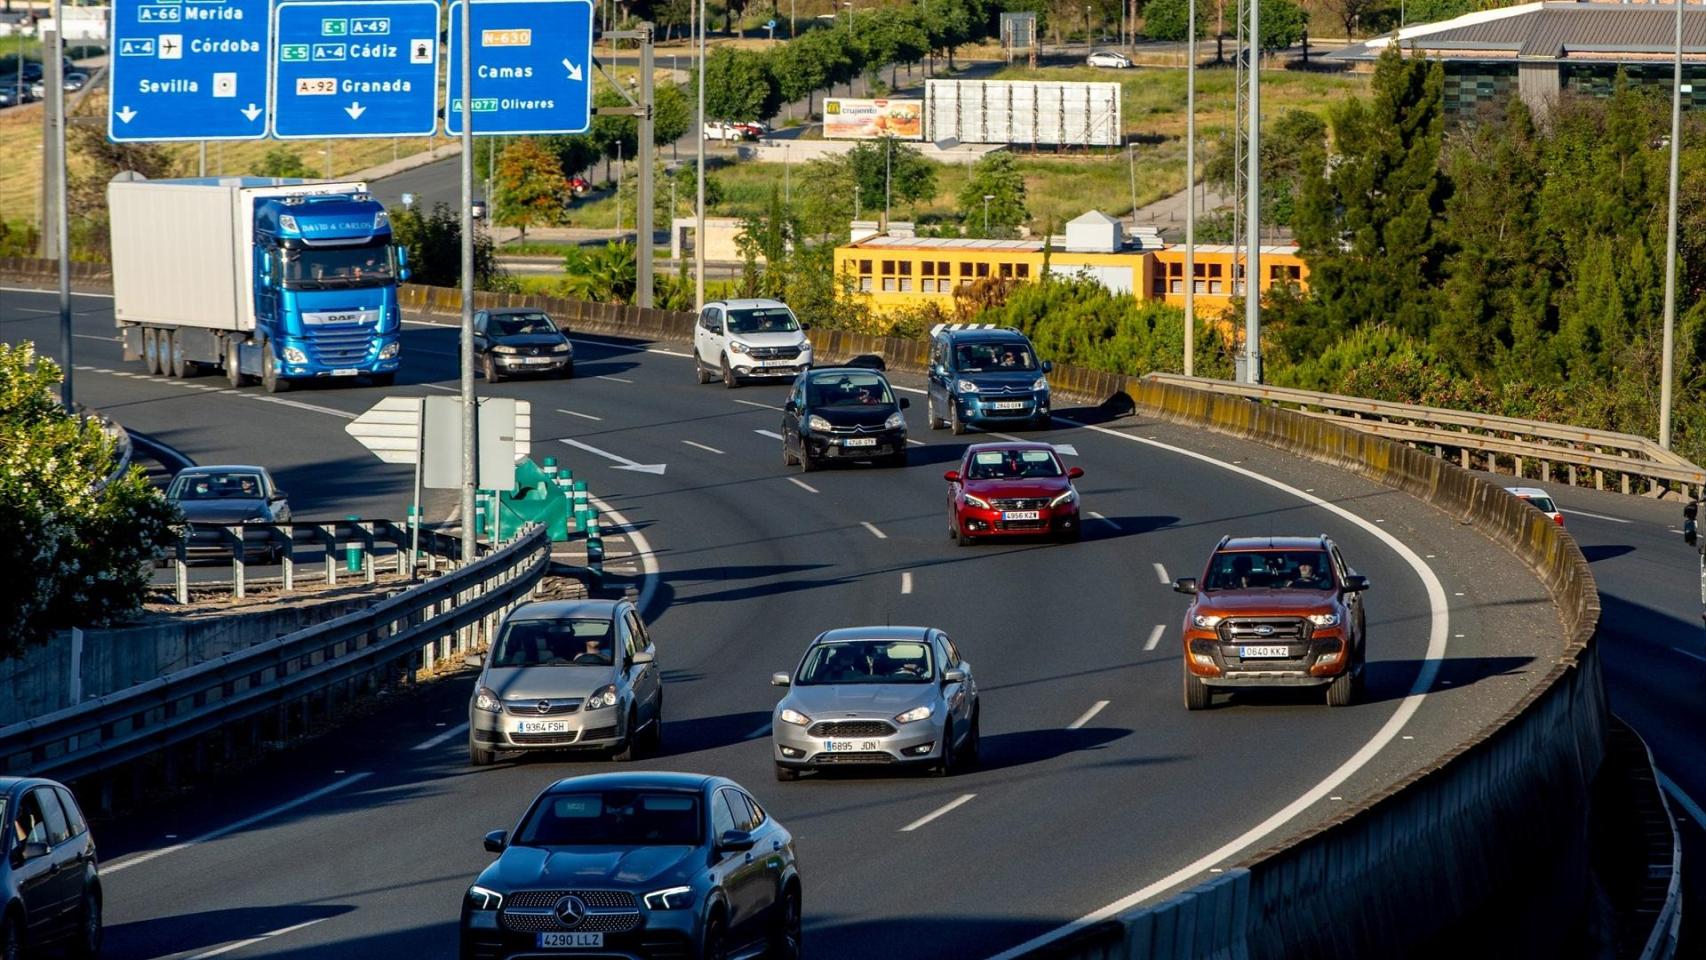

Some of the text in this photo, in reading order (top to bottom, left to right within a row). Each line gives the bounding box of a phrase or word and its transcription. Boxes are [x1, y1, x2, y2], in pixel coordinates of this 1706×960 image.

[141, 6, 243, 20] A-66 Merida
[323, 20, 388, 33] E-1 A-49
[484, 32, 529, 44] N-630
[122, 38, 259, 54] A-4 Córdoba
[282, 43, 397, 58] E-5 A-4 Cádiz
[478, 65, 533, 78] Camas
[139, 79, 198, 93] Sevilla
[300, 78, 411, 93] A-92 Granada
[501, 99, 555, 109] Olivares
[1247, 647, 1287, 655] 0640 KKZ
[832, 741, 852, 750] 6895
[544, 934, 599, 946] 4290 LLZ
